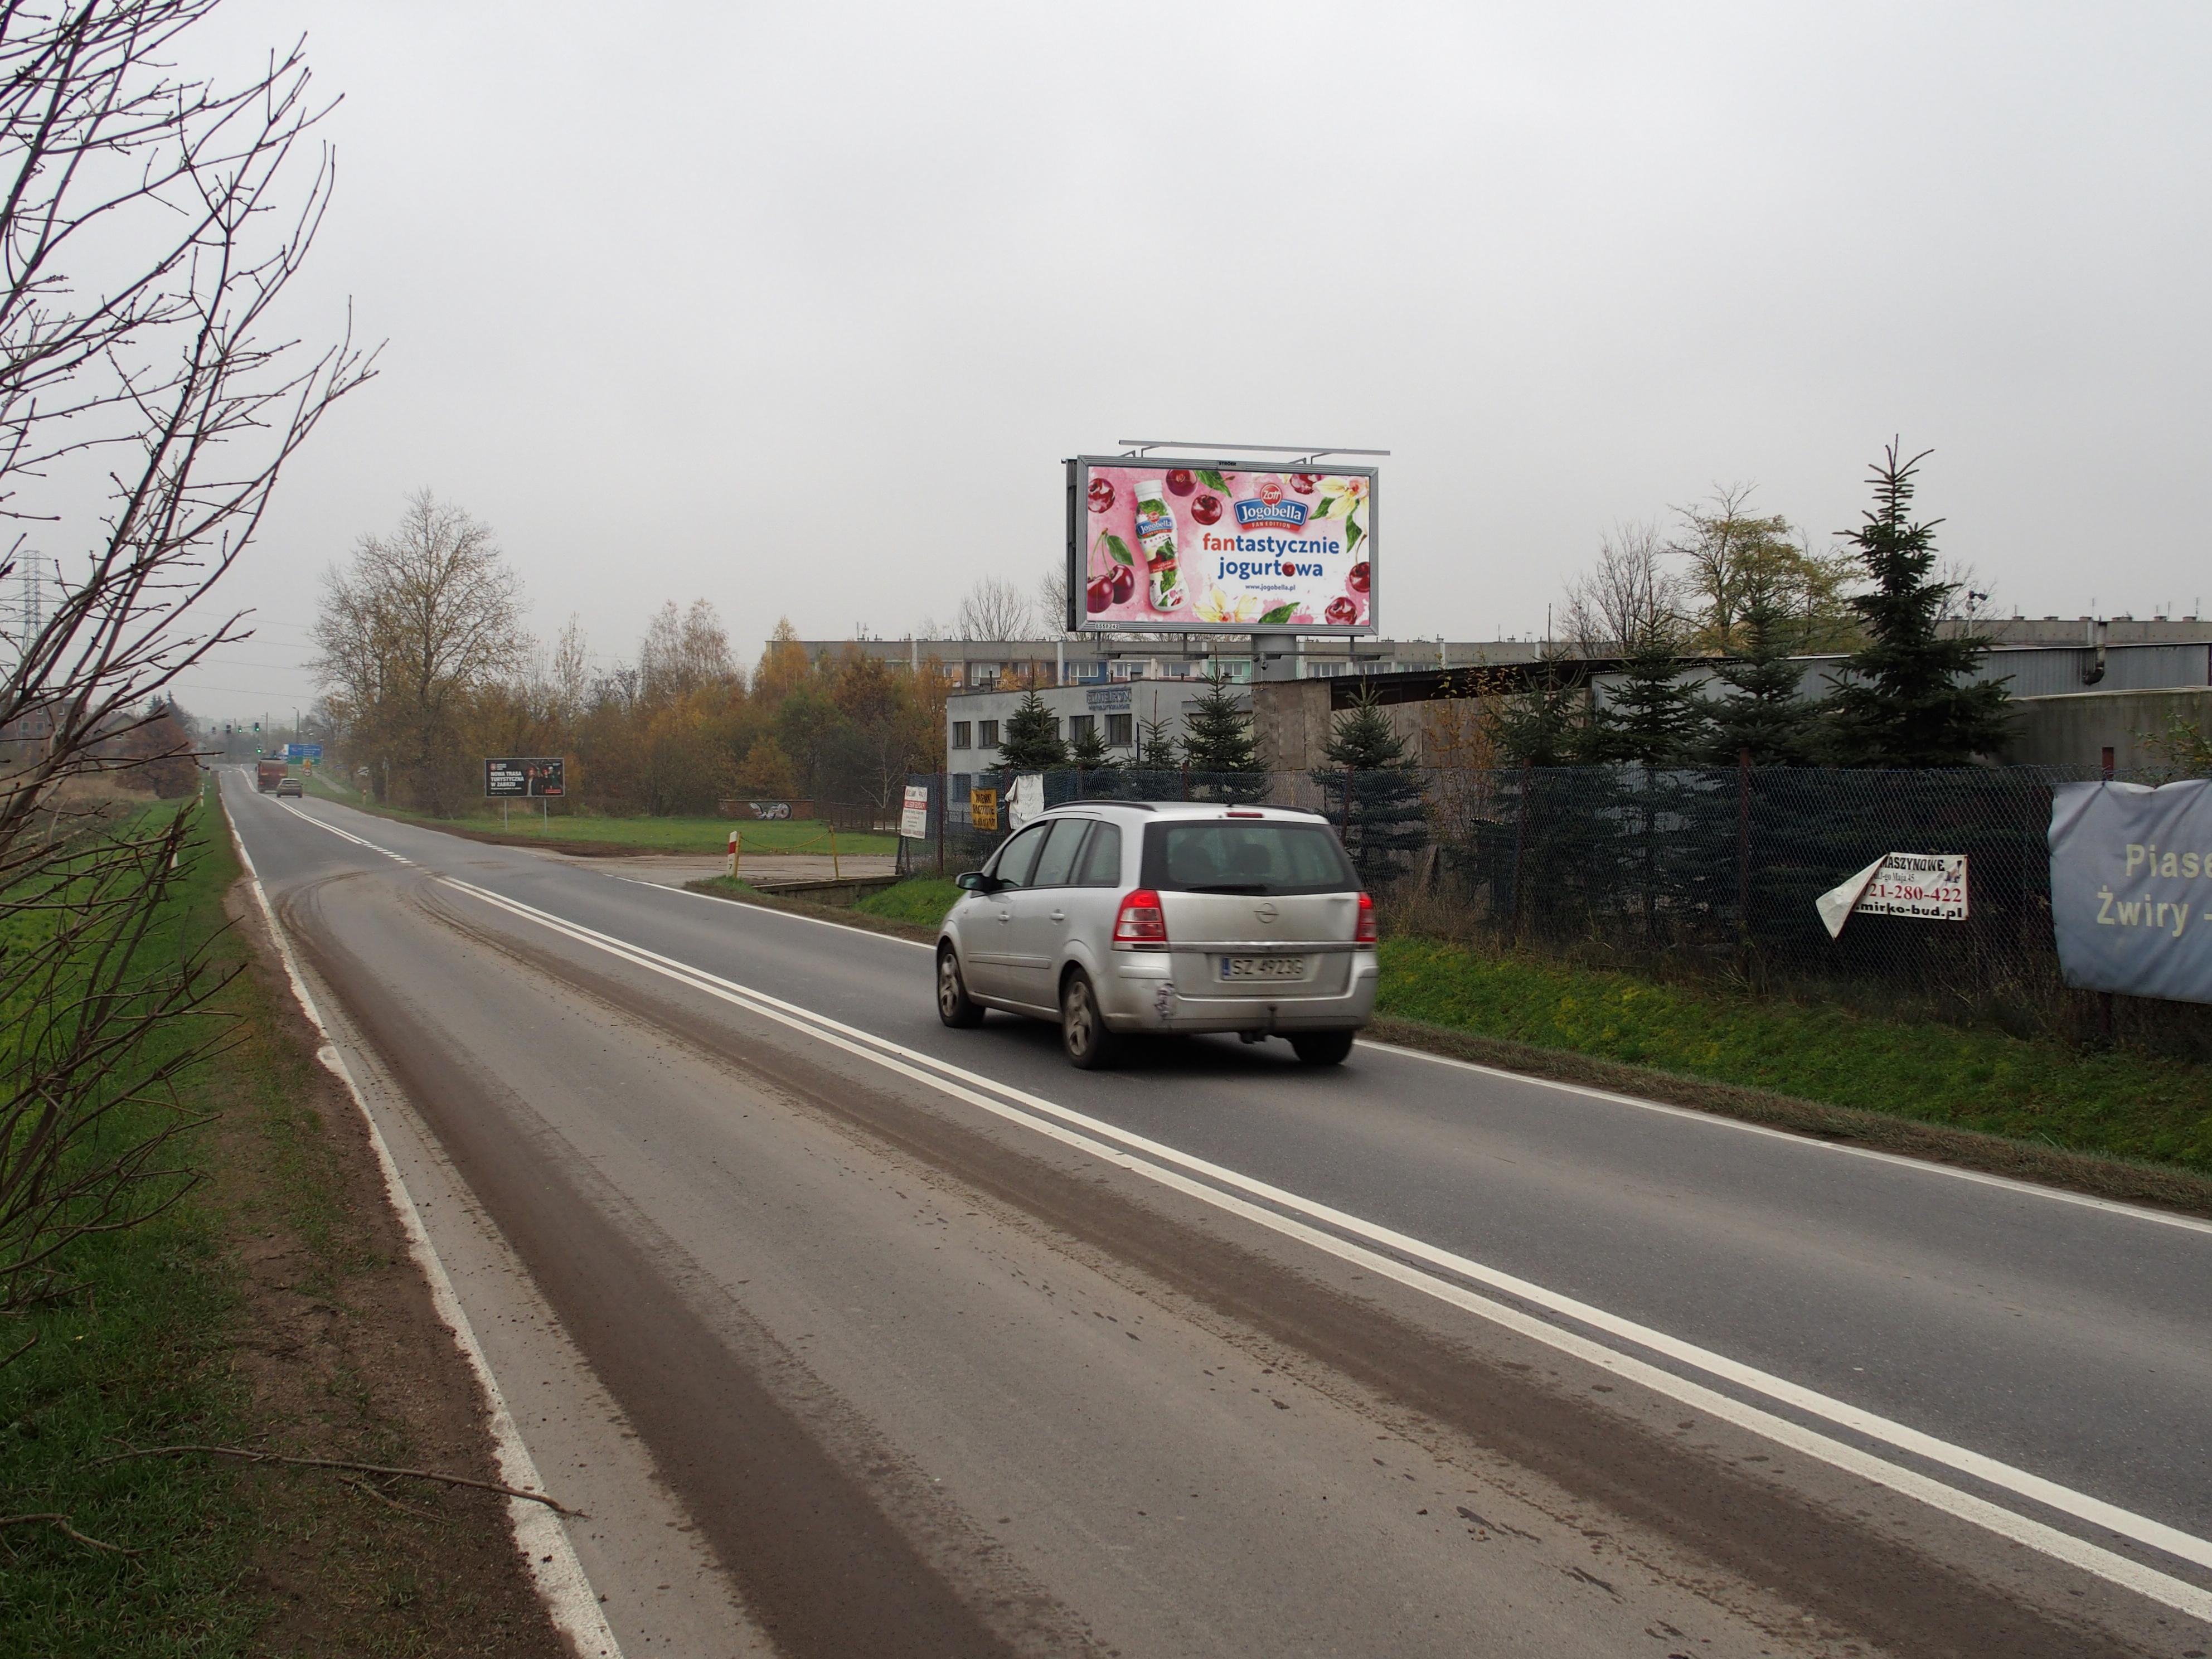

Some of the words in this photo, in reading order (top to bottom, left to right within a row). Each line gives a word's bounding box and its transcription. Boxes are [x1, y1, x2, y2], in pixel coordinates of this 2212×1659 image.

[1263, 491, 1280, 500] Zott
[1241, 503, 1302, 521] Jogobella
[1203, 532, 1340, 557] fantastycznie
[1893, 872, 1906, 884] Maja
[2097, 885, 2189, 937] Żwiry
[1233, 959, 1253, 974] SZ
